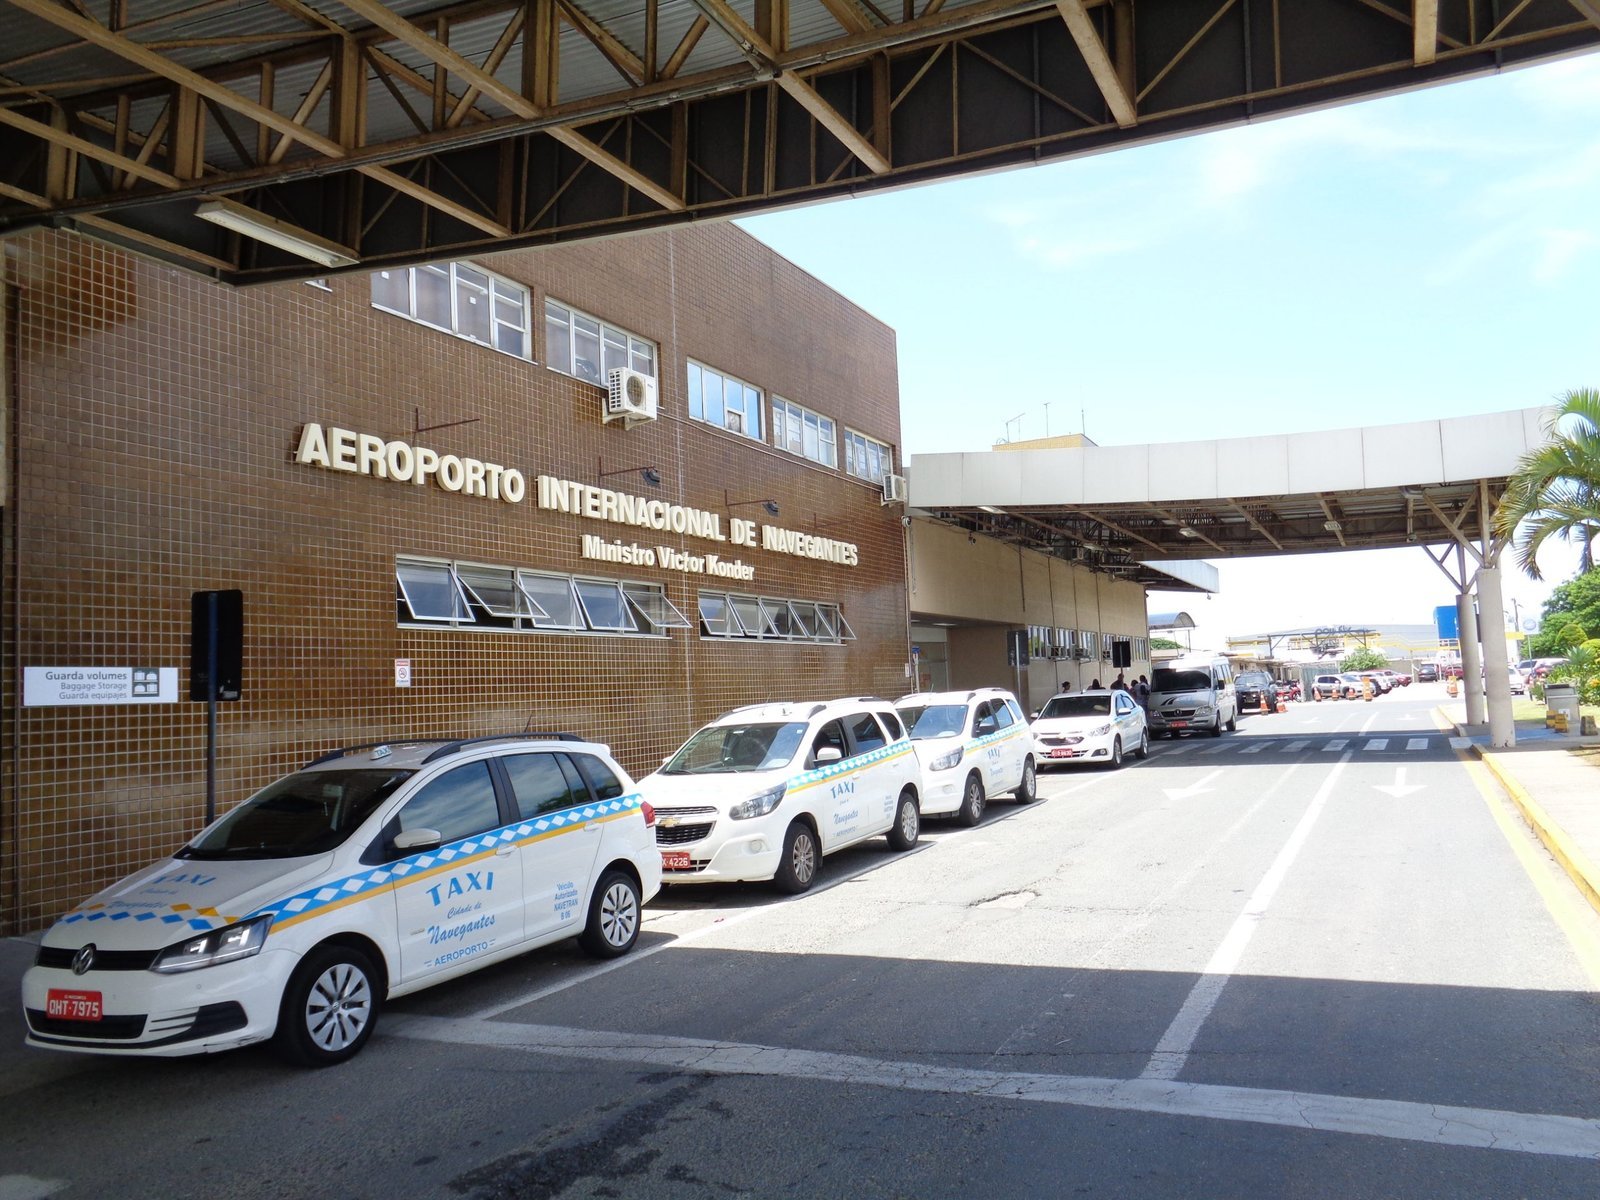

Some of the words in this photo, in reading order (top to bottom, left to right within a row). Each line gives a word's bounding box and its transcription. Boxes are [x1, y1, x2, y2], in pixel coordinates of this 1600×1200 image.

[295, 422, 525, 503] AEROPORTO
[537, 474, 726, 541] INTERNACIONAL
[730, 518, 756, 547] DE
[761, 525, 858, 566] NAVEGANTES
[581, 534, 655, 567] Ministro
[655, 545, 705, 573] Victor
[704, 554, 755, 581] Konder
[45, 671, 84, 680] Guarda
[87, 671, 128, 680] volumes
[60, 682, 96, 691] Baggage
[98, 682, 127, 691] Storage
[59, 692, 89, 700] Guarda
[91, 692, 128, 700] equipajes
[830, 781, 854, 799] TAXI
[425, 871, 494, 907] TAXI
[447, 904, 472, 920] Cidade
[473, 901, 482, 910] de
[427, 914, 496, 945] Navegantes
[434, 941, 489, 967] AEROPORTO
